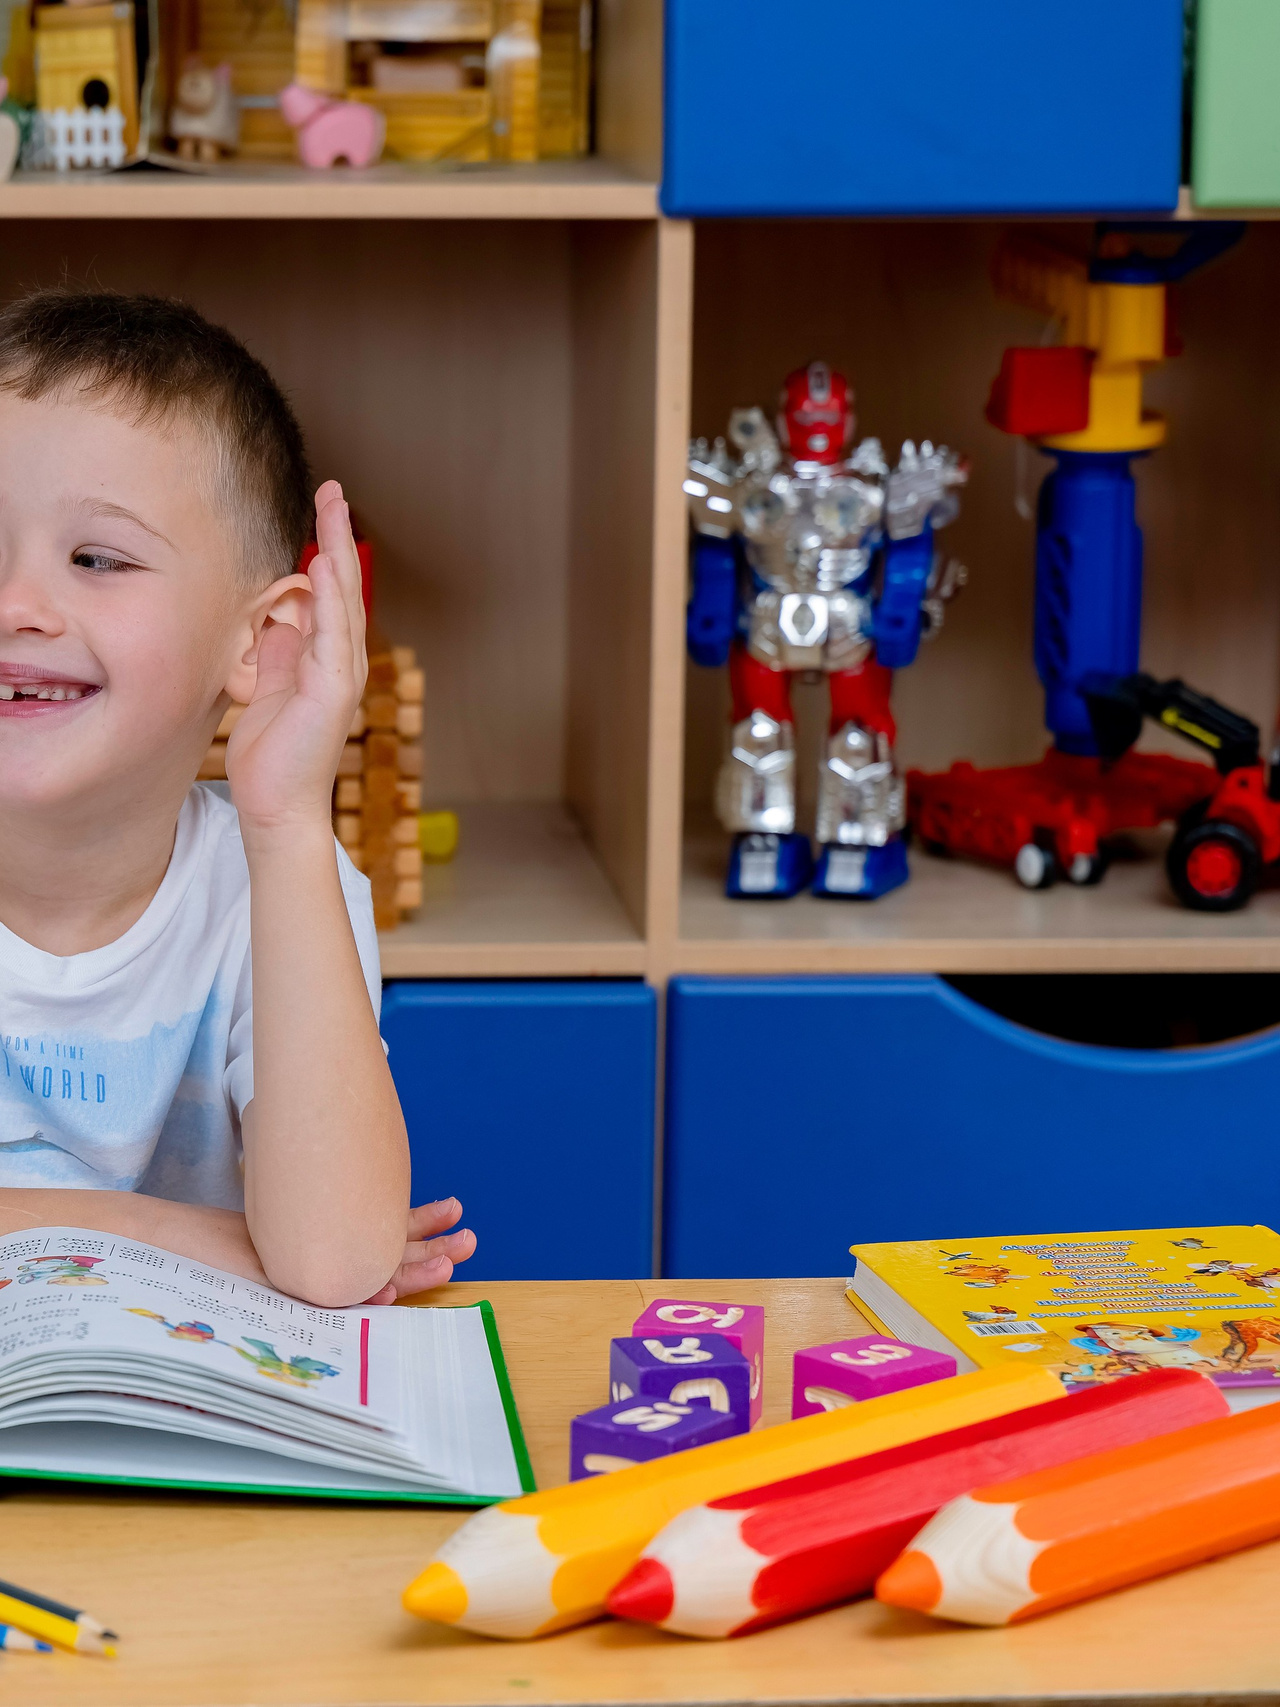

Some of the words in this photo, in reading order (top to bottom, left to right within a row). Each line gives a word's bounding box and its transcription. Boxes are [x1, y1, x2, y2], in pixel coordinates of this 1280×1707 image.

[39, 1040, 45, 1054] A
[56, 1043, 84, 1060] TIME
[20, 1064, 106, 1103] WORLD
